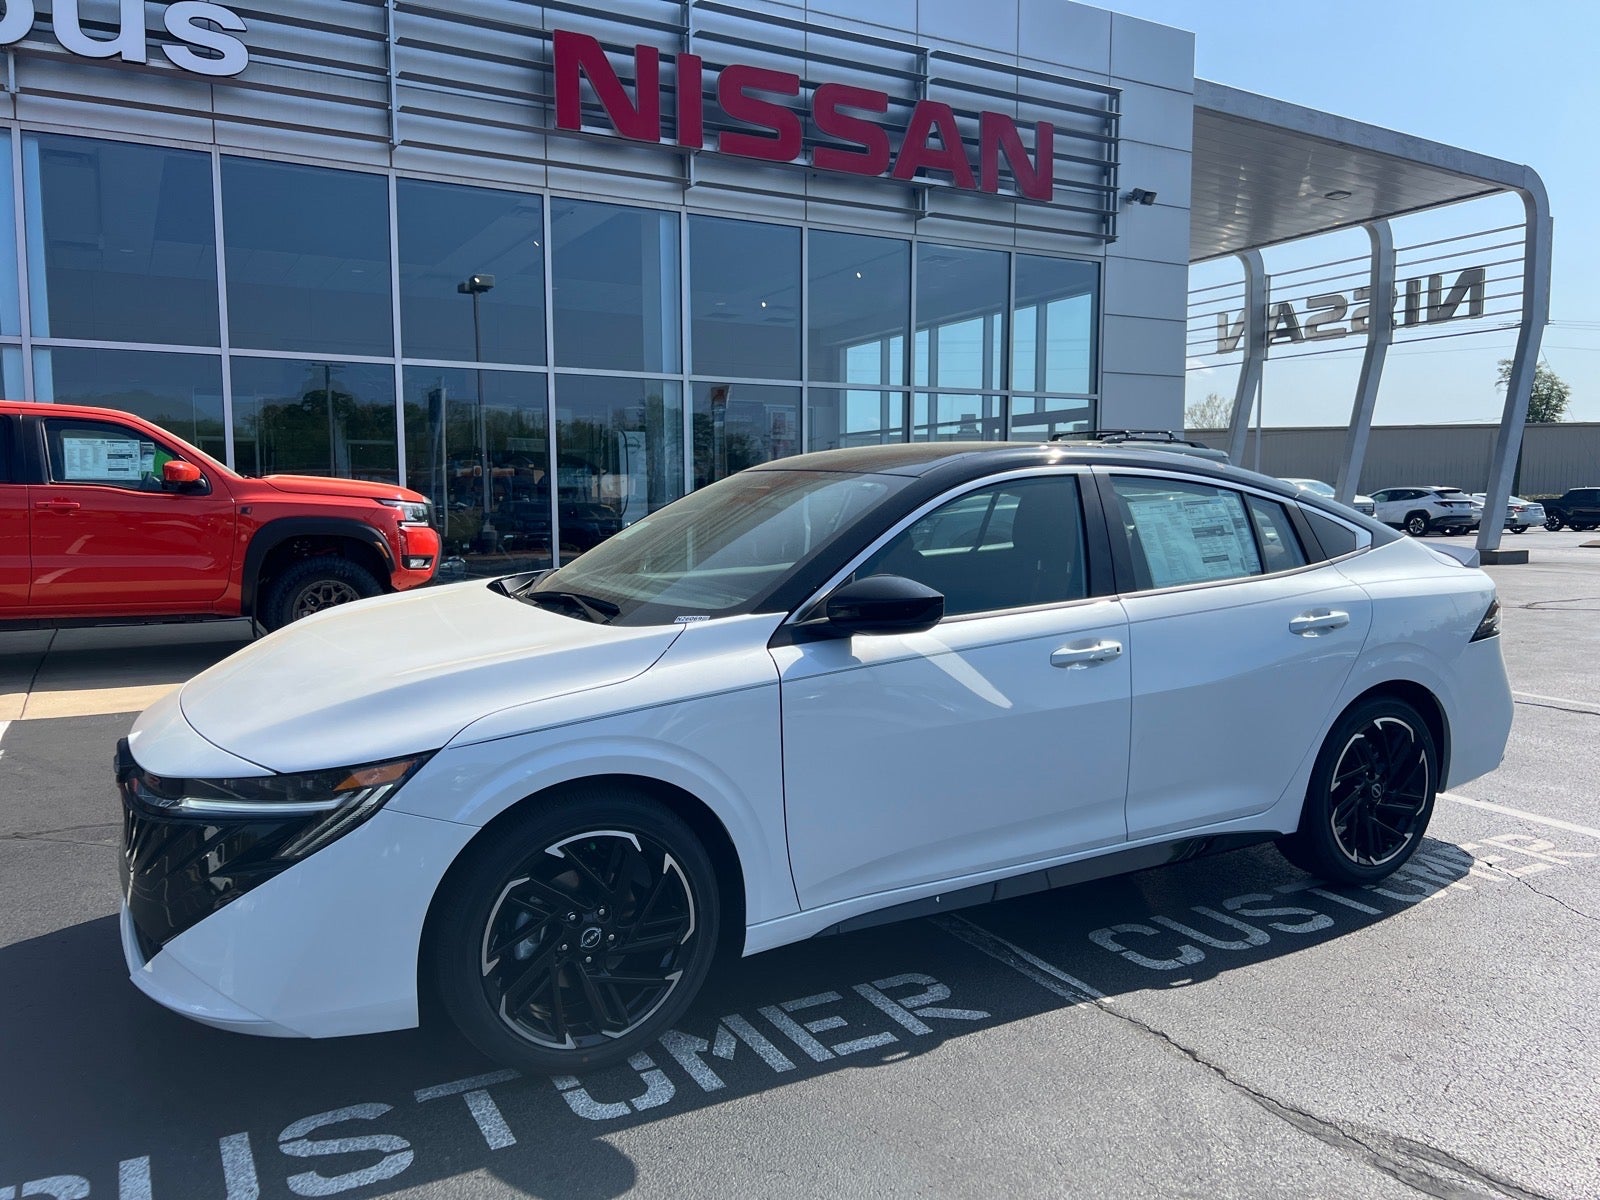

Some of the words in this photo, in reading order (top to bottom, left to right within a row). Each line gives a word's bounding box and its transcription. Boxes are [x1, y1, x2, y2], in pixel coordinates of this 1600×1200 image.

[552, 29, 1054, 202] NISSAN
[1088, 834, 1599, 971] CUSTOMER
[0, 973, 991, 1200] USTOMER
